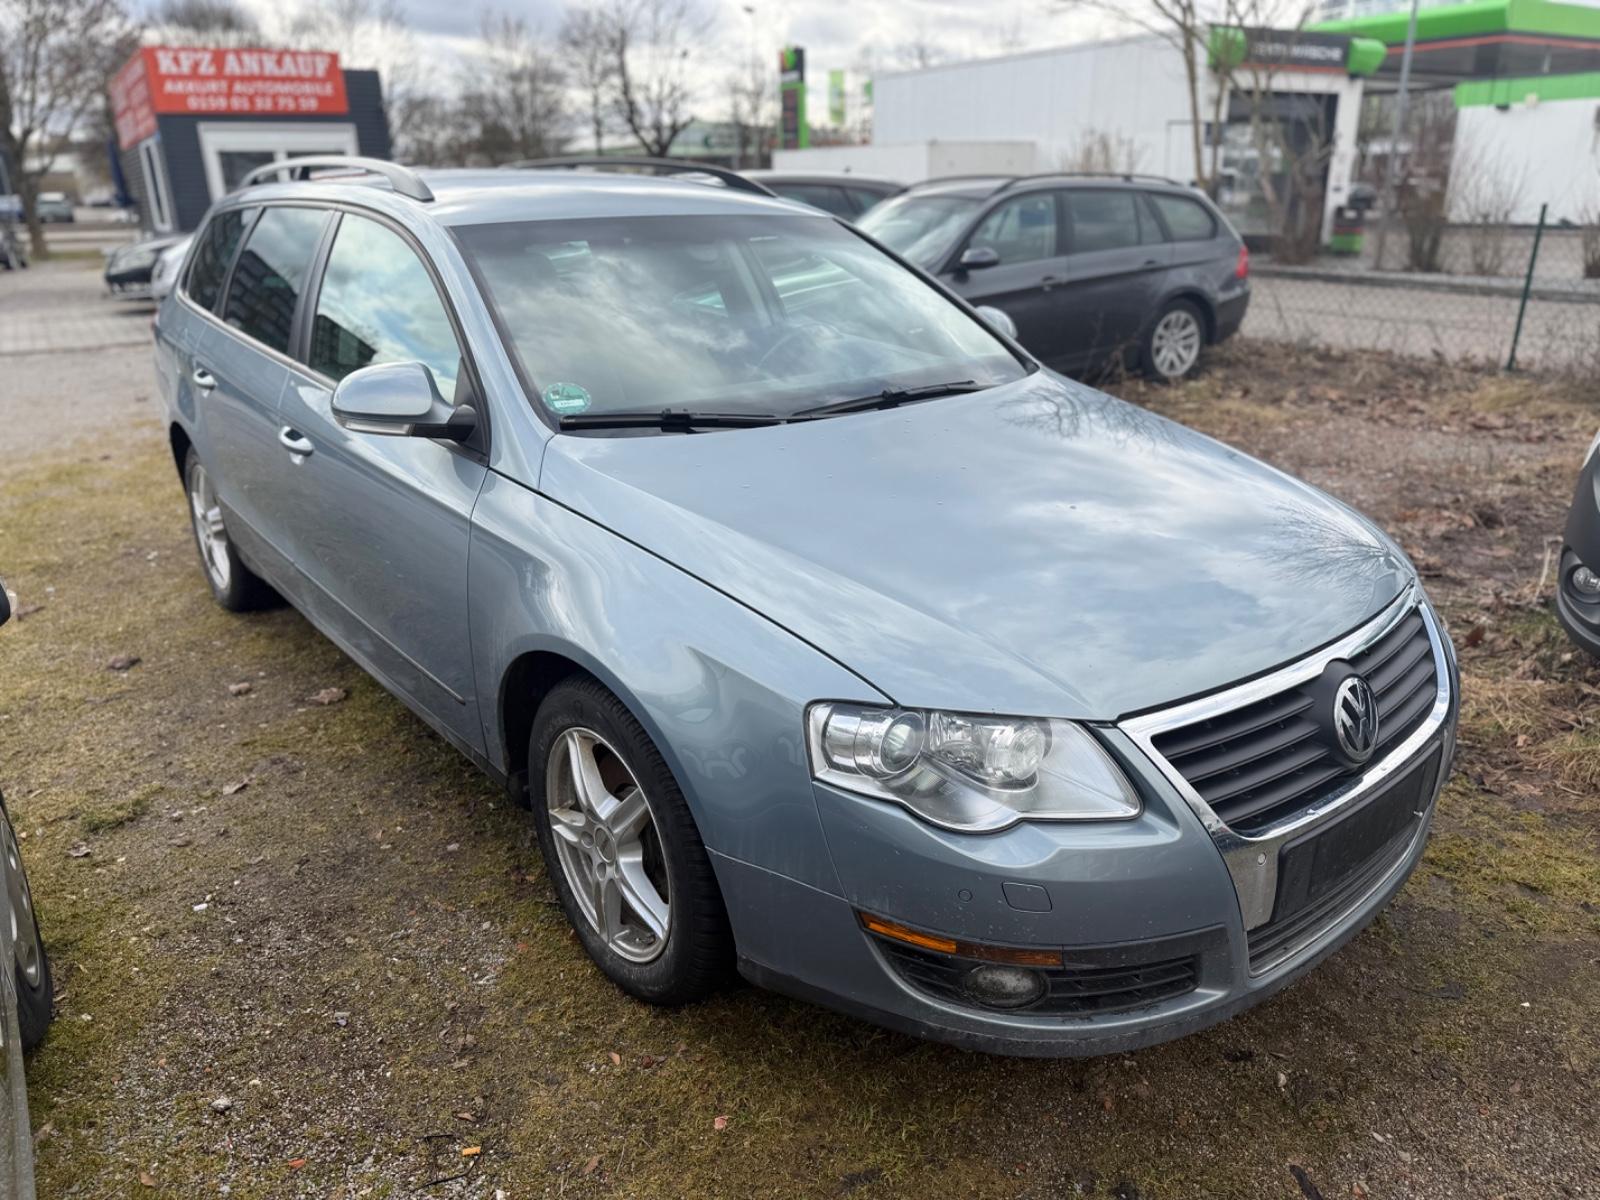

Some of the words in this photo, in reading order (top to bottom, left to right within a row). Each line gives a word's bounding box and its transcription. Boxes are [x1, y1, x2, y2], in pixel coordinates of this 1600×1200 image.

[157, 51, 215, 75] KFZ
[225, 52, 331, 78] ANKAUF
[232, 81, 334, 96] AUTOMOBILE
[1336, 680, 1377, 760] VW
